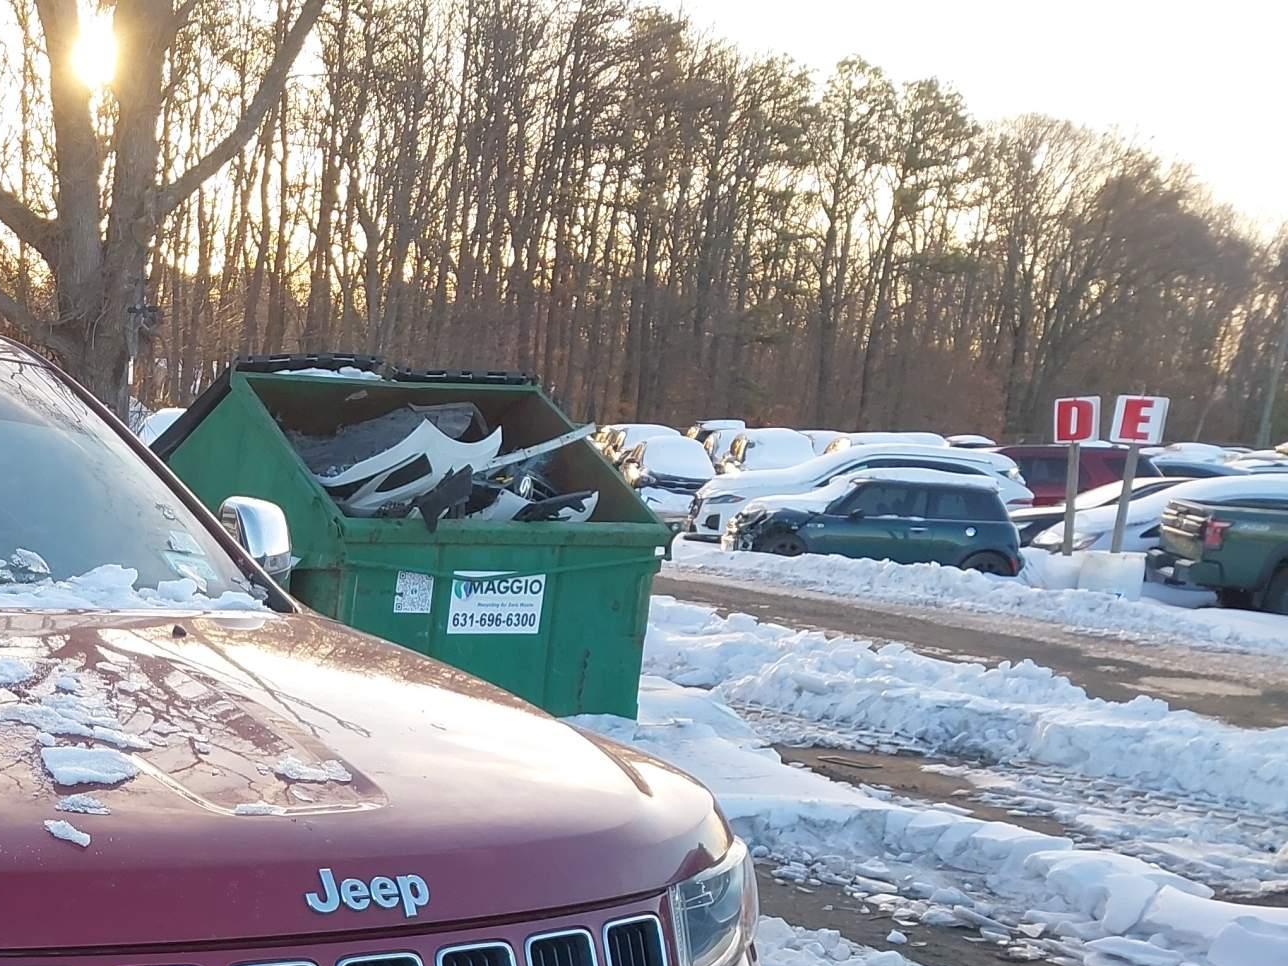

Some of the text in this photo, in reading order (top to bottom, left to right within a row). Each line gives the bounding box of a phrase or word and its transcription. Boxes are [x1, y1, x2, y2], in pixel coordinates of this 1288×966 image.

[1057, 400, 1094, 441] D
[1119, 398, 1155, 440] E
[469, 579, 543, 595] MAGGIO
[452, 612, 536, 627] 631-696-6300
[305, 868, 430, 918] Jeep
